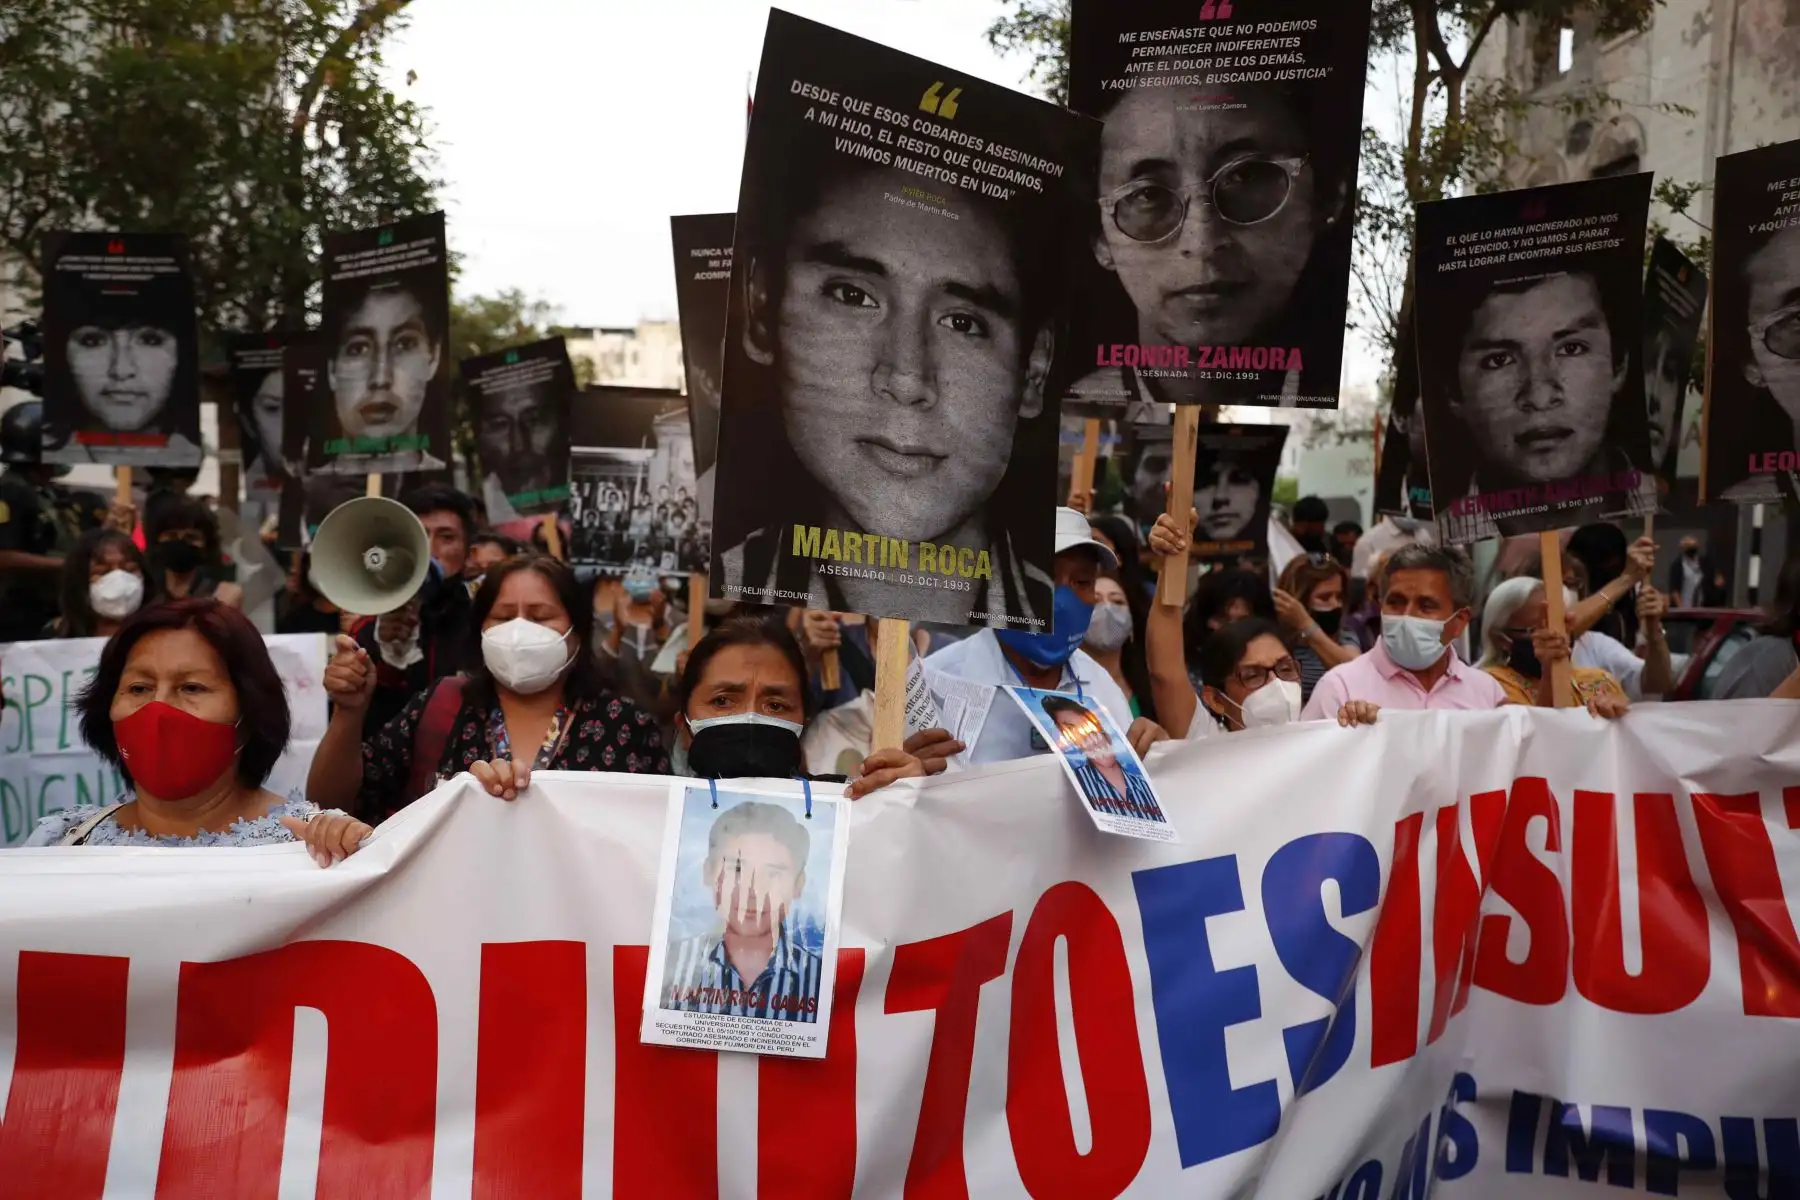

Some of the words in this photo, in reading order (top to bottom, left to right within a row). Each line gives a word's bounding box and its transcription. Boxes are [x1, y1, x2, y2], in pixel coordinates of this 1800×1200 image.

[1119, 32, 1137, 44] ME
[1139, 26, 1206, 42] ENSEÑASTE
[1208, 25, 1233, 39] QUE
[1236, 23, 1254, 35] NO
[1256, 19, 1318, 34] PODEMOS
[1132, 41, 1213, 58] PERMANECER
[1214, 36, 1301, 53] INDIFERENTES
[1124, 60, 1154, 74] ANTE
[1157, 60, 1171, 71] EL
[1173, 57, 1212, 71] DOLOR
[1215, 56, 1231, 68] DE
[1234, 54, 1257, 67] LOS
[1259, 50, 1307, 66] DEMÁS,
[1100, 79, 1110, 91] Y
[1139, 73, 1202, 88] SEGUIMOS,
[1205, 70, 1272, 85] BUSCANDO
[790, 79, 840, 106] DESDE
[842, 95, 873, 116] QUE
[874, 106, 910, 128] ESOS
[912, 118, 984, 151] COBARDES
[985, 142, 1064, 178] ASESINARON
[804, 107, 815, 120] A
[818, 111, 837, 128] MI
[839, 117, 874, 140] HIJO,
[877, 129, 894, 145] EL
[896, 134, 941, 159] RESTO
[942, 149, 970, 168] QUE
[972, 157, 1045, 192] QUEDAMOS,
[834, 137, 891, 165] VIVIMOS
[893, 155, 958, 185] MUERTOS
[960, 176, 979, 191] EN
[1767, 180, 1787, 192] ME
[884, 192, 906, 205] Padre
[906, 199, 917, 208] de
[941, 209, 960, 220] Roca
[1446, 235, 1457, 246] EL
[1459, 232, 1478, 245] QUE
[1480, 230, 1492, 240] LO
[1494, 226, 1524, 238] HAYAN
[1525, 219, 1583, 233] INCINERADO
[1584, 216, 1598, 226] NO
[1599, 212, 1619, 224] NOS
[1748, 224, 1756, 234] Y
[690, 247, 722, 257] NUNCA
[1453, 247, 1467, 258] HA
[1513, 239, 1520, 248] Y
[1520, 237, 1534, 248] NO
[1536, 232, 1568, 245] VAMOS
[1569, 231, 1577, 241] A
[1578, 227, 1610, 240] PARAR
[1438, 261, 1467, 273] HASTA
[1469, 254, 1506, 268] LOGRAR
[1508, 246, 1563, 261] ENCONTRAR
[1564, 243, 1583, 253] SUS
[1096, 343, 1190, 368] LEONOR
[1196, 346, 1304, 371] ZAMORA
[1137, 370, 1188, 379] ASESINADA
[792, 524, 910, 570] MARTIN
[918, 540, 993, 581] ROCA
[818, 563, 885, 581] ASESINADO
[1131, 832, 1381, 1169] ES
[683, 1013, 725, 1022] ESTUDIANTE
[738, 1017, 773, 1025] ECONOMIA
[695, 1020, 740, 1029] UNIVERSIDAD
[655, 1022, 706, 1032] SECUESTRADO
[757, 1031, 797, 1040] CONDUCIDO
[661, 1029, 703, 1038] TORTURADO
[704, 1033, 742, 1041] ASESINADO
[749, 1037, 791, 1046] INCINERADO
[676, 1037, 712, 1046] GOBIERNO
